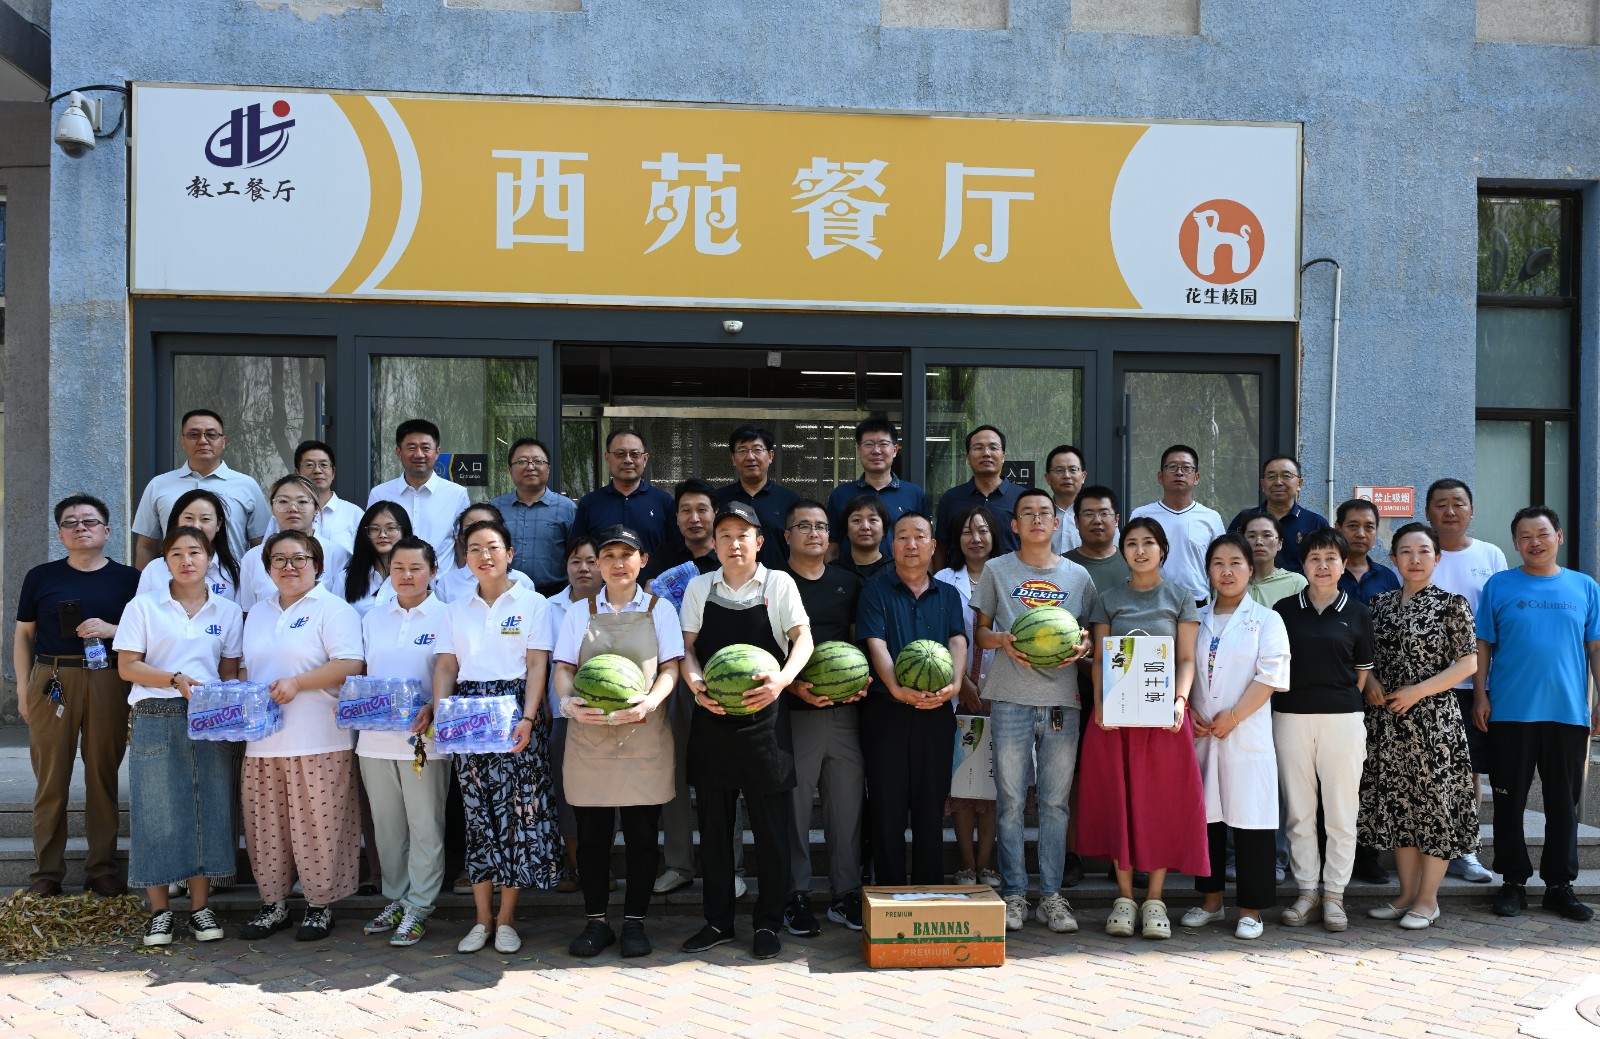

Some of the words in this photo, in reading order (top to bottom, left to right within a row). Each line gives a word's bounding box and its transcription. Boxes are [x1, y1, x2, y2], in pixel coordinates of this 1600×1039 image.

[185, 175, 296, 203] 教工餐厅
[491, 149, 1036, 263] 西苑餐厅
[1185, 287, 1257, 306] 花生校园
[457, 461, 482, 472] 入口
[1006, 468, 1029, 478] 入口
[1374, 492, 1410, 503] 禁止吸烟
[1017, 588, 1065, 600] Dickies
[1527, 599, 1577, 612] Columbia
[1143, 661, 1165, 703] 纯牛奶
[885, 910, 913, 918] PREMIUM
[912, 920, 970, 936] BANANAS
[903, 948, 950, 957] PREMIUM
